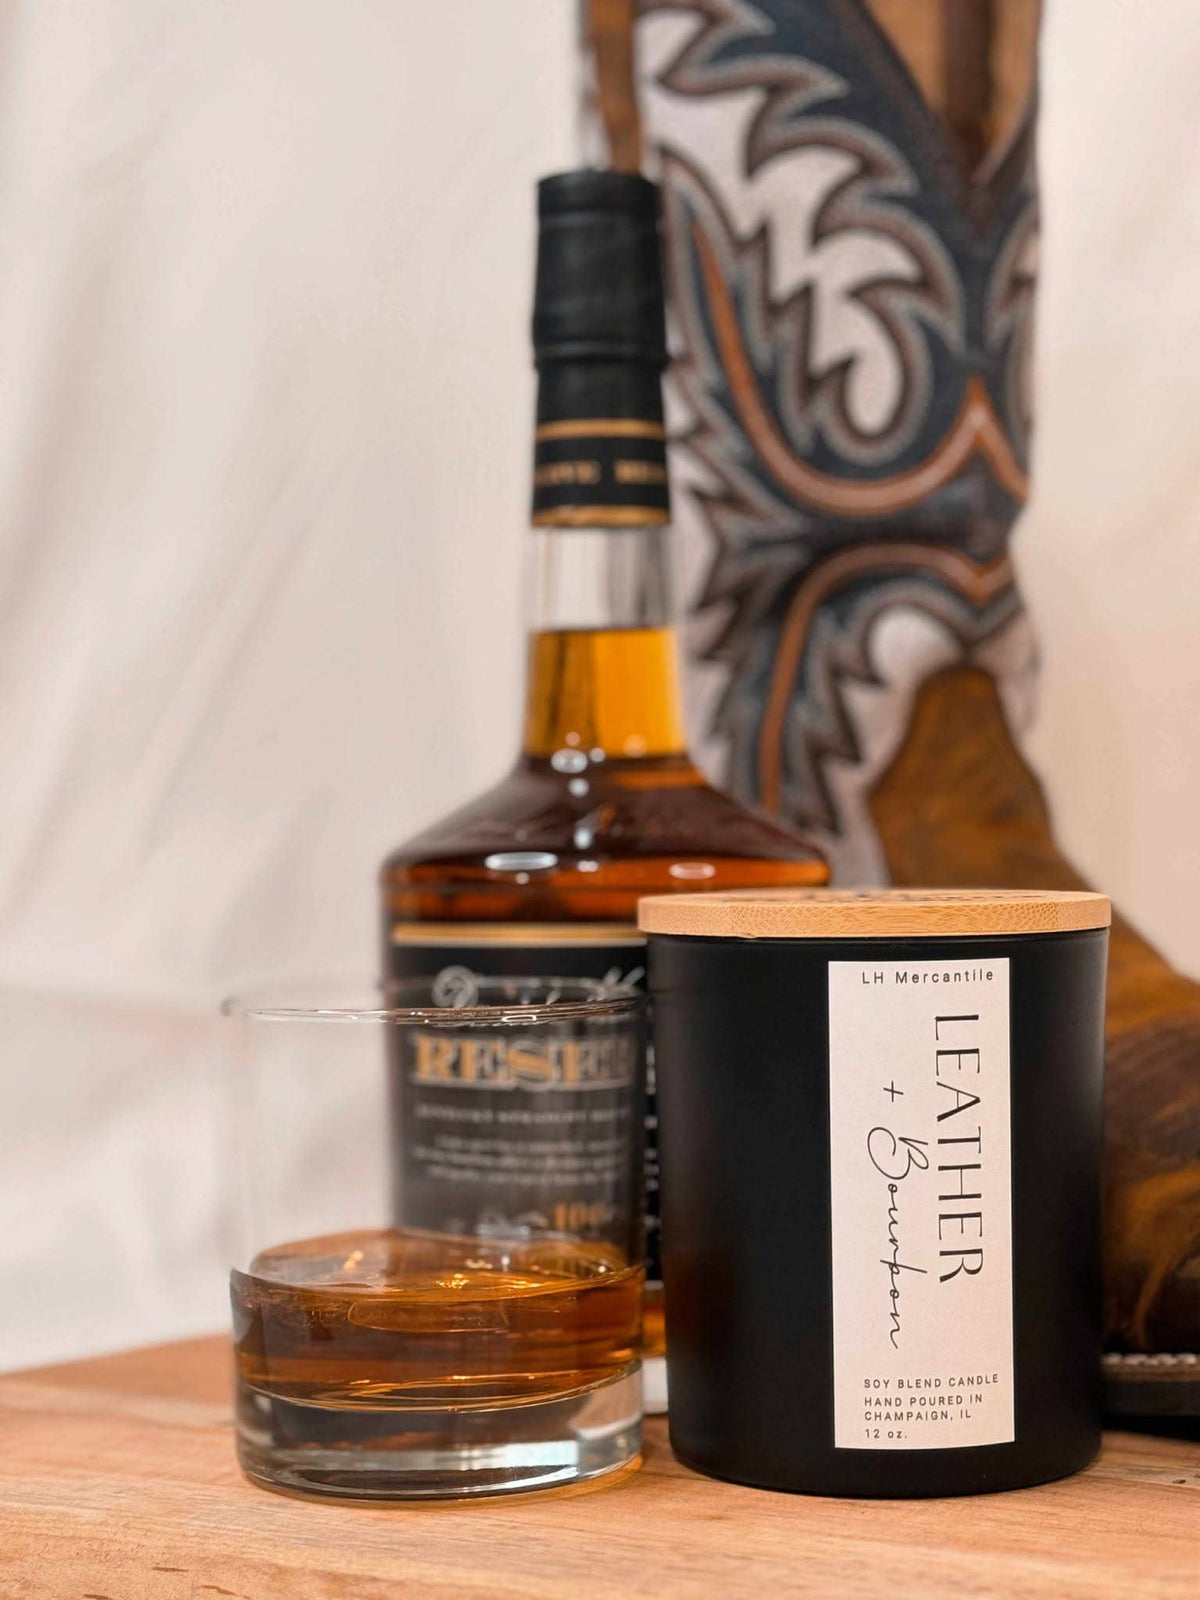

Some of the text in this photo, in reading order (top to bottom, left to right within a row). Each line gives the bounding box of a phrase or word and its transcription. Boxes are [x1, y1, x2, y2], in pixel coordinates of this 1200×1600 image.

[861, 968, 994, 985] LH Mercantile
[934, 1013, 985, 1284] LEATHER
[867, 1126, 929, 1350] Bourbon
[863, 1373, 999, 1390] SOY BLEND CANDLE
[863, 1393, 983, 1408] HAND POURED IN
[863, 1408, 972, 1422] CHAMPAIGN, IL
[864, 1428, 909, 1440] 12 oz.
